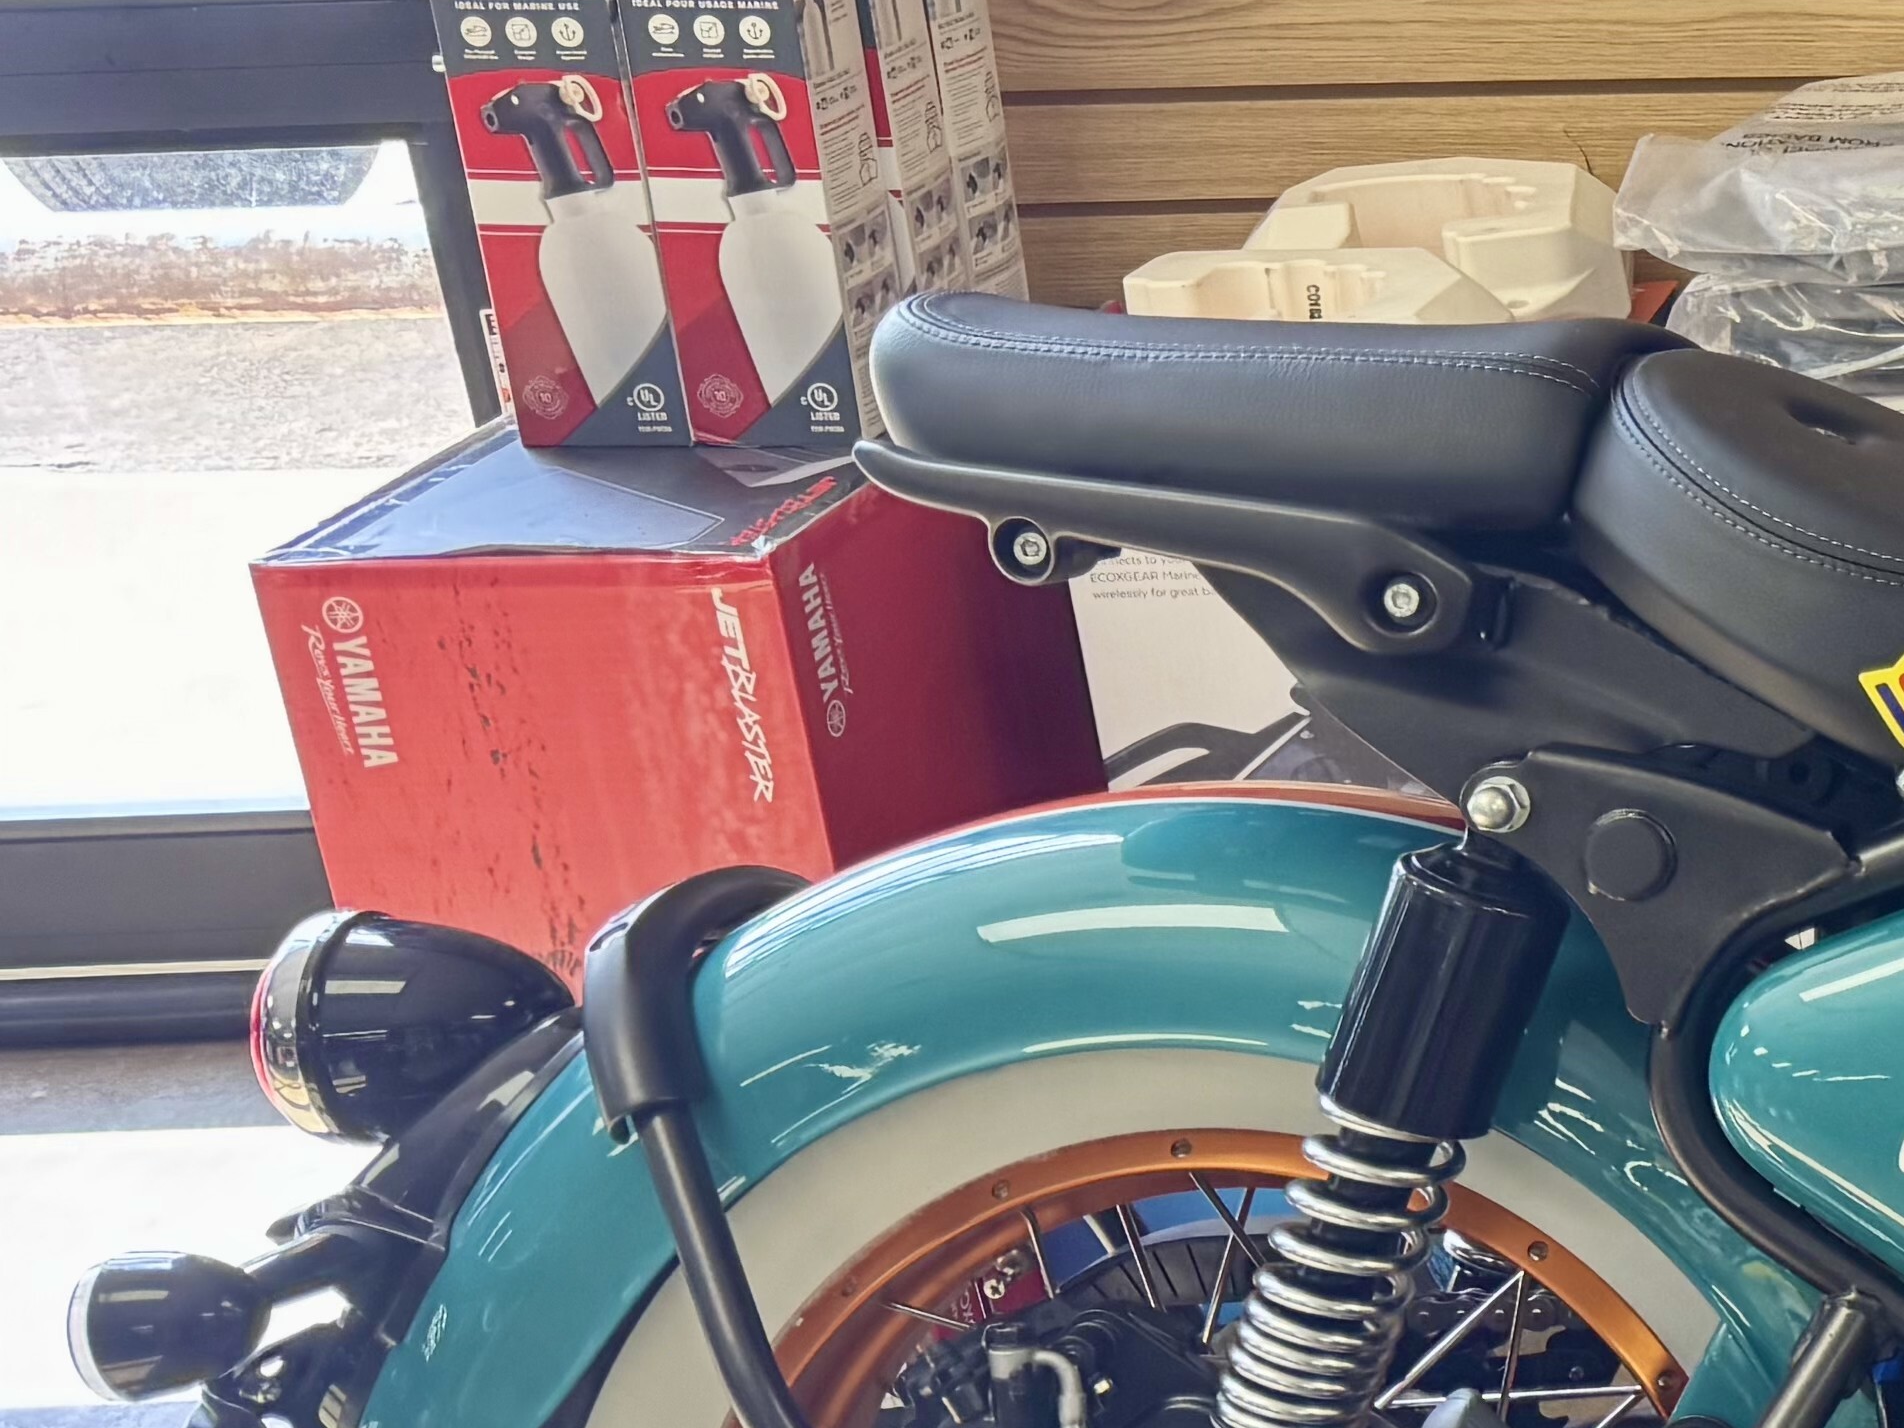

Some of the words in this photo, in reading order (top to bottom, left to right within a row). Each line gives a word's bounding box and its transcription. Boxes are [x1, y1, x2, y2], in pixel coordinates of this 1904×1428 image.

[455, 1, 485, 10] IDEAL
[489, 2, 509, 10] FOR
[513, 2, 555, 10] MARINE
[699, 0, 734, 9] USAGE
[1090, 571, 1159, 583] ECOXGEAR
[1093, 590, 1147, 599] wirelessly
[1152, 589, 1167, 597] for
[1171, 588, 1198, 599] great
[798, 564, 837, 702] YAMAHA
[710, 587, 775, 803] JETBLASTER
[333, 635, 400, 769] YAMAHA
